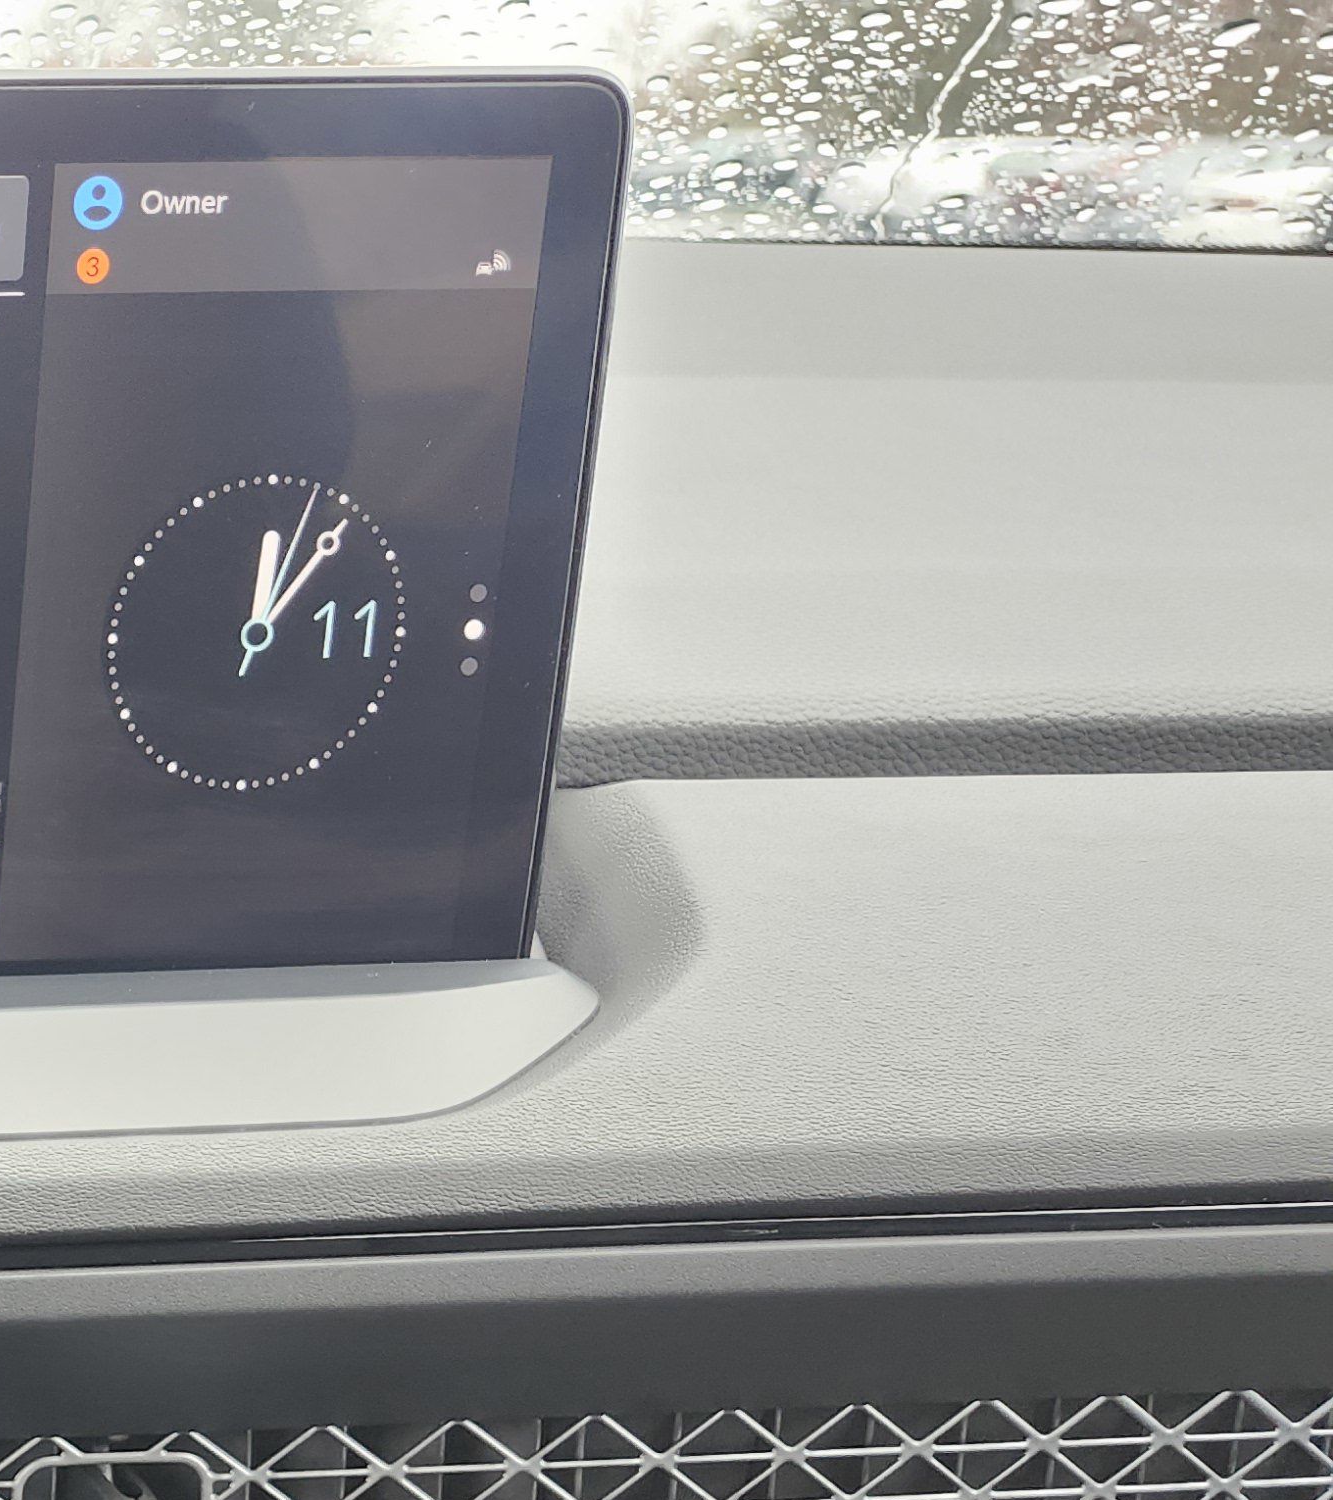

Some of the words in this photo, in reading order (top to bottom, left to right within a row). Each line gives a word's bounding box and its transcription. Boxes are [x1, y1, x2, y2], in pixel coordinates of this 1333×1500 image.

[140, 190, 228, 215] Owner
[85, 256, 100, 277] 3
[313, 600, 377, 658] 11
